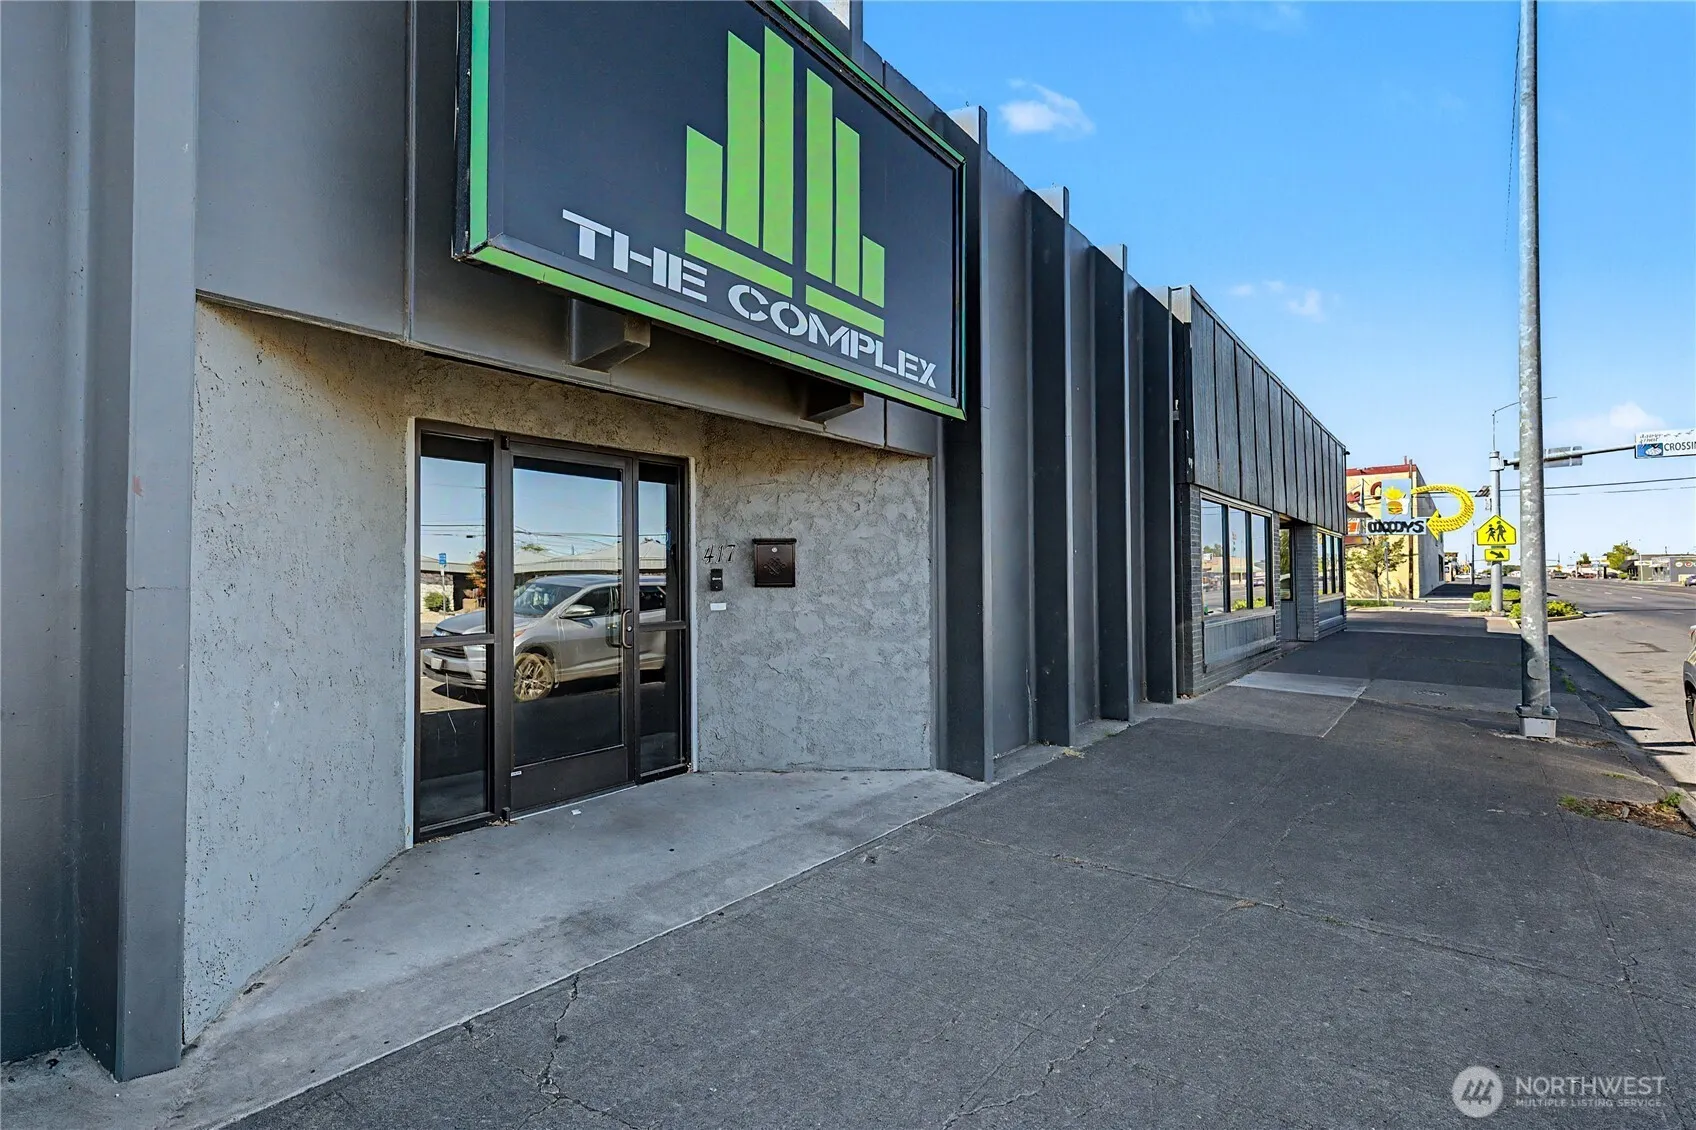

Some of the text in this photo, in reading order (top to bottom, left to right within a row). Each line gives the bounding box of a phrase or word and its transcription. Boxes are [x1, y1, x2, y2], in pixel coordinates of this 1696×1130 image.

[562, 209, 938, 389] THE COMPLEX
[703, 544, 737, 564] 417
